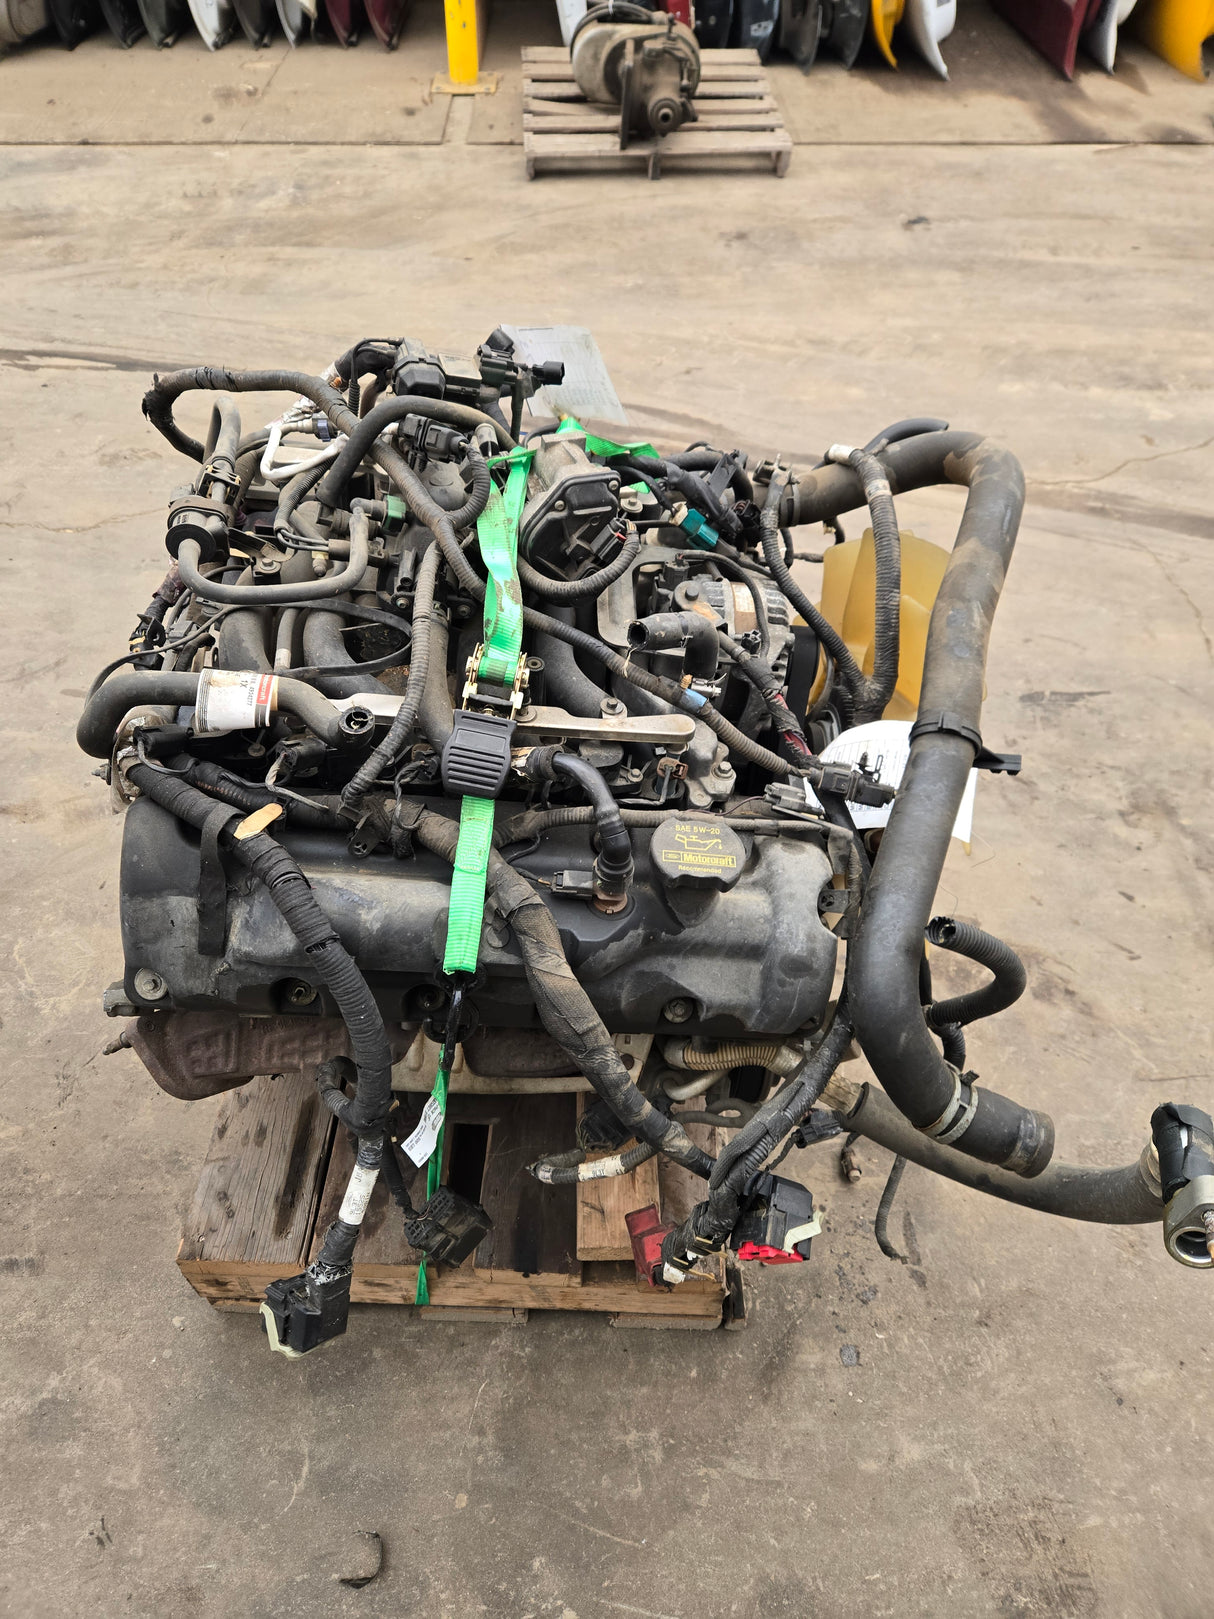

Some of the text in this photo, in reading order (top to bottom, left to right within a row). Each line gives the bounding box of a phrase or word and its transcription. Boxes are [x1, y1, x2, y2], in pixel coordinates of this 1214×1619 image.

[693, 826, 720, 835] 5W-20
[683, 853, 733, 865] Motorcraft
[678, 865, 722, 873] Recommended
